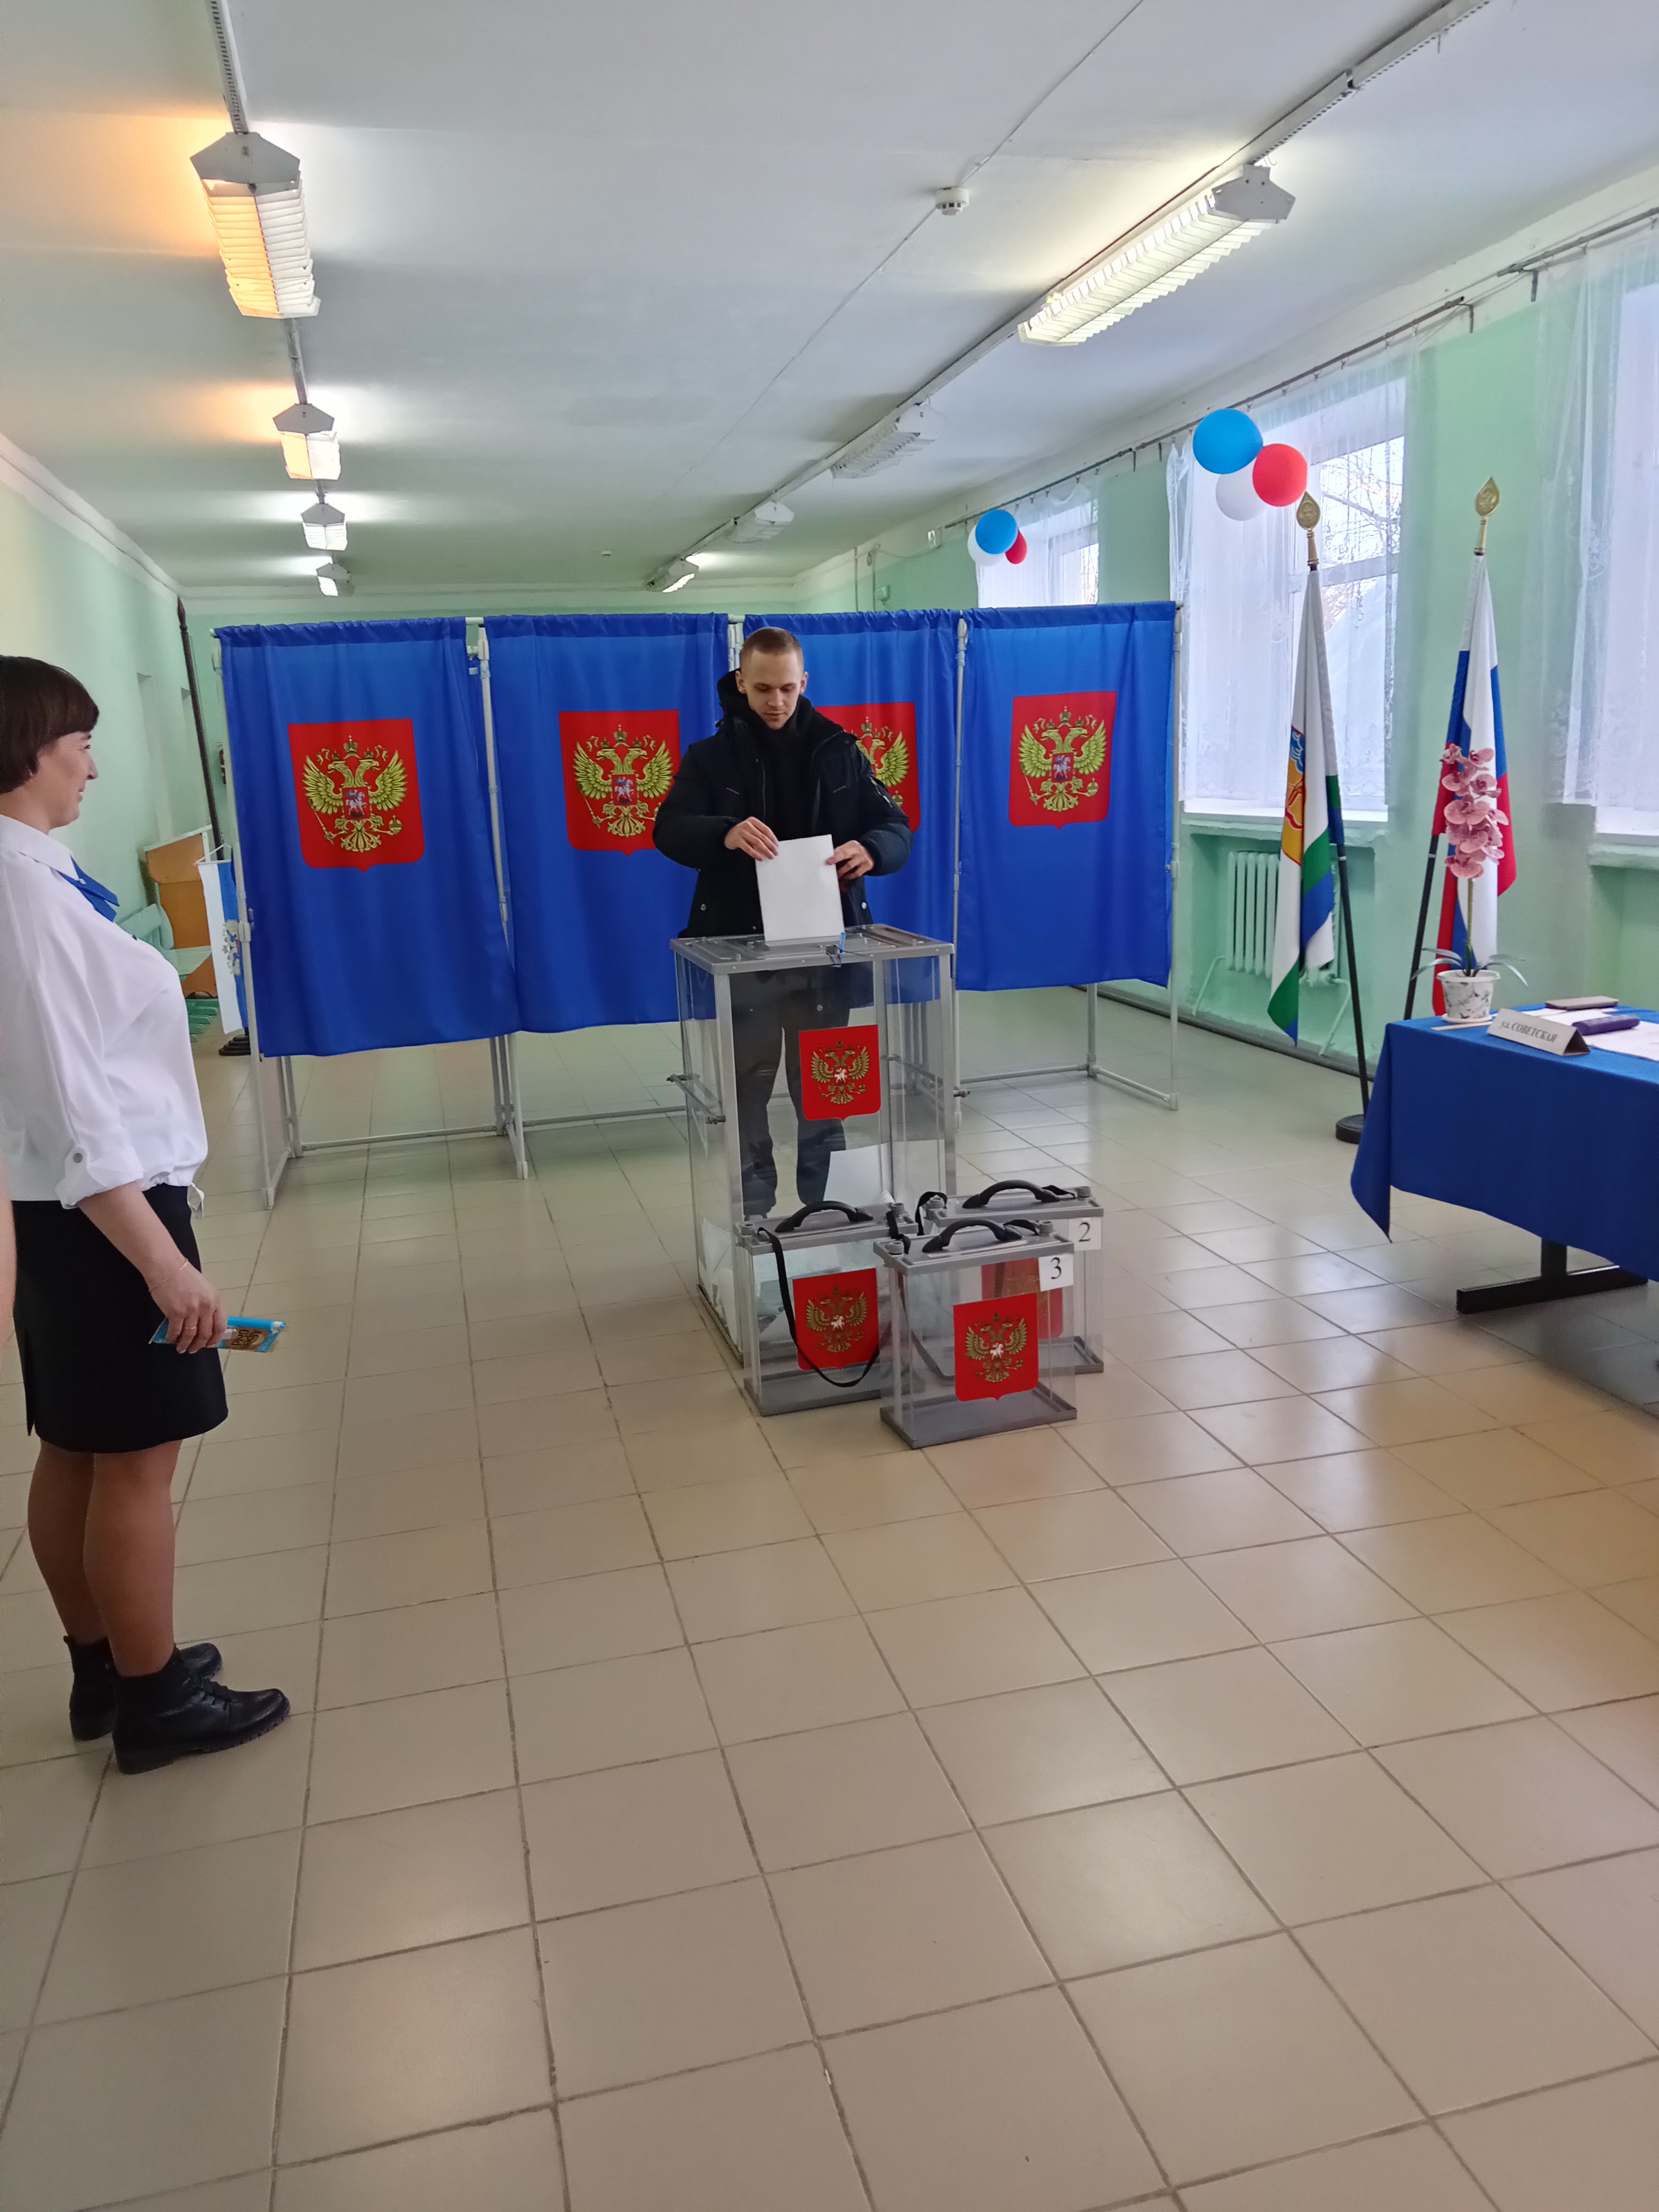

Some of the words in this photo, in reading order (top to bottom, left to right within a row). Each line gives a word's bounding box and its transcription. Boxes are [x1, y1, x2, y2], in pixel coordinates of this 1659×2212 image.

[1511, 1023, 1558, 1042] СОВЕТСКАЯ
[1078, 1222, 1091, 1242] 2
[1051, 1257, 1062, 1279] 3
[231, 1329, 249, 1346] Gold
[240, 1330, 262, 1348] Alpen
